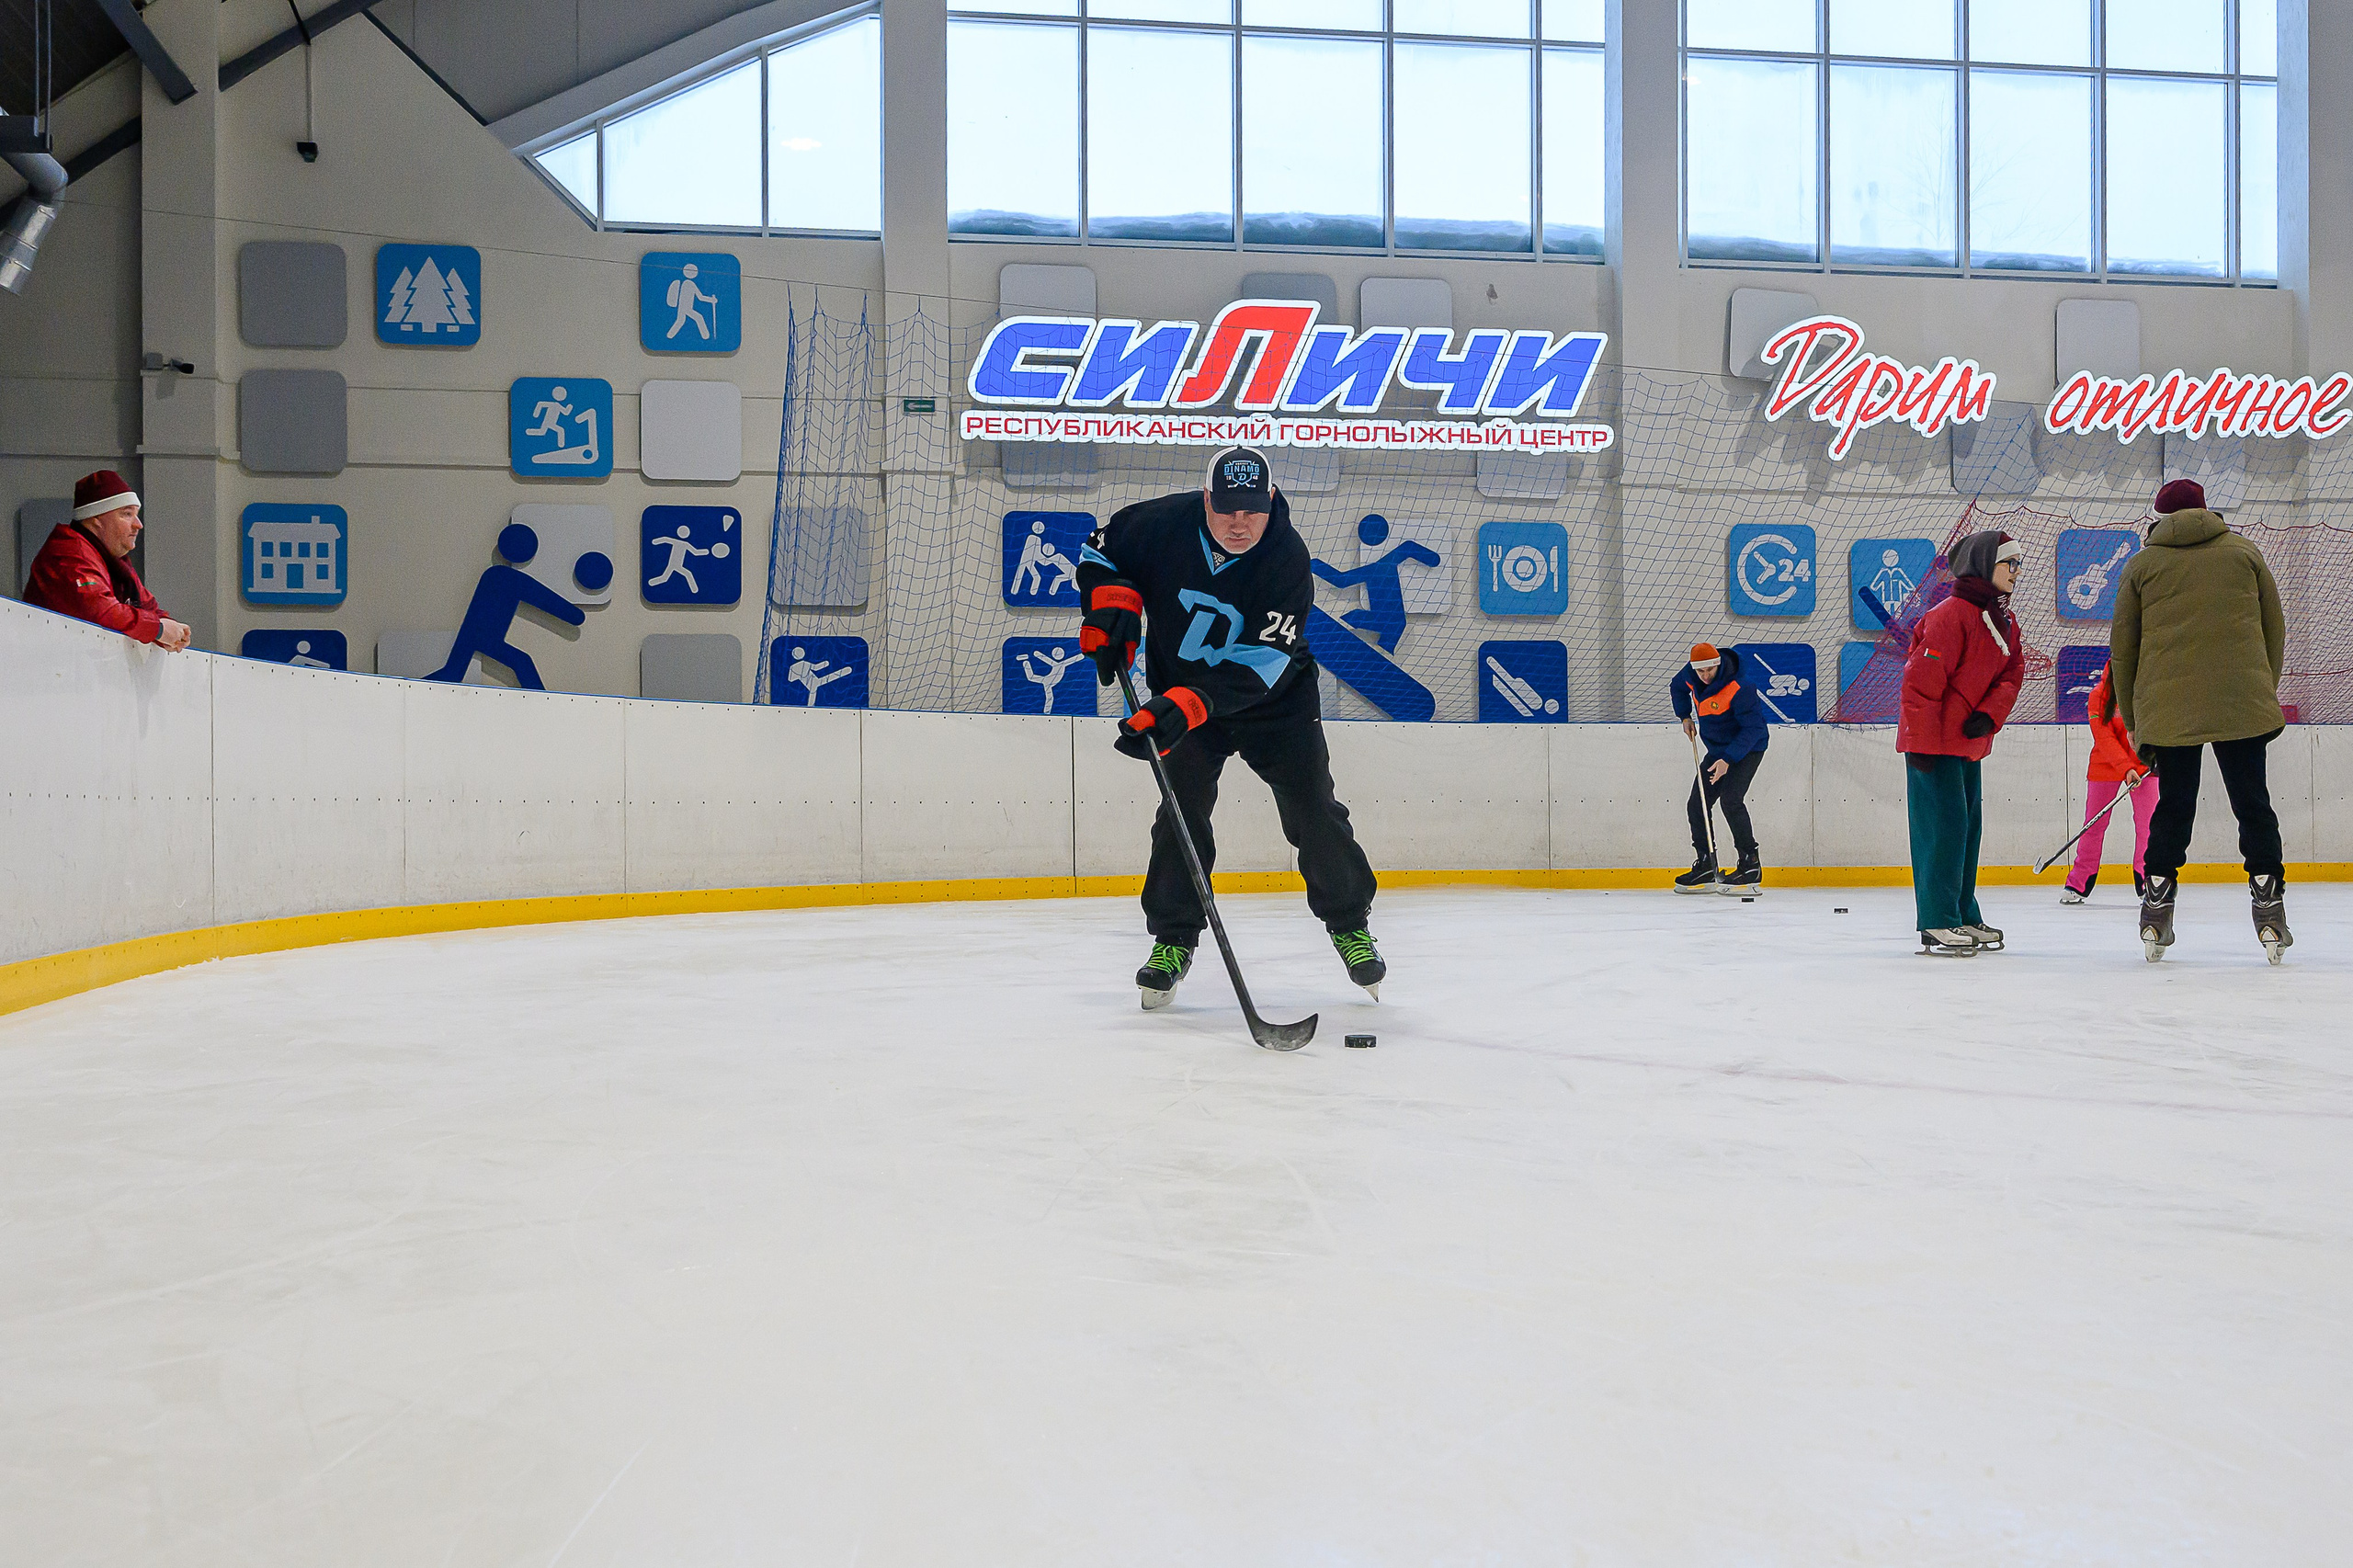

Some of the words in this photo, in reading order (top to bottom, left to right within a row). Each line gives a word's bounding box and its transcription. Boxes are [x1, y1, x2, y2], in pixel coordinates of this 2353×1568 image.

[1767, 322, 1991, 454] Дарим
[2050, 373, 2350, 439] отличное
[965, 416, 1271, 440] РЕСПУБЛИКАНСКИЙ
[1279, 424, 1512, 444] ГОРНОЛЫЖНЫЙ
[1520, 429, 1608, 449] ЦЕНТР
[1224, 465, 1259, 473] DINAMO
[1778, 558, 1812, 582] 24
[1259, 610, 1297, 645] 24
